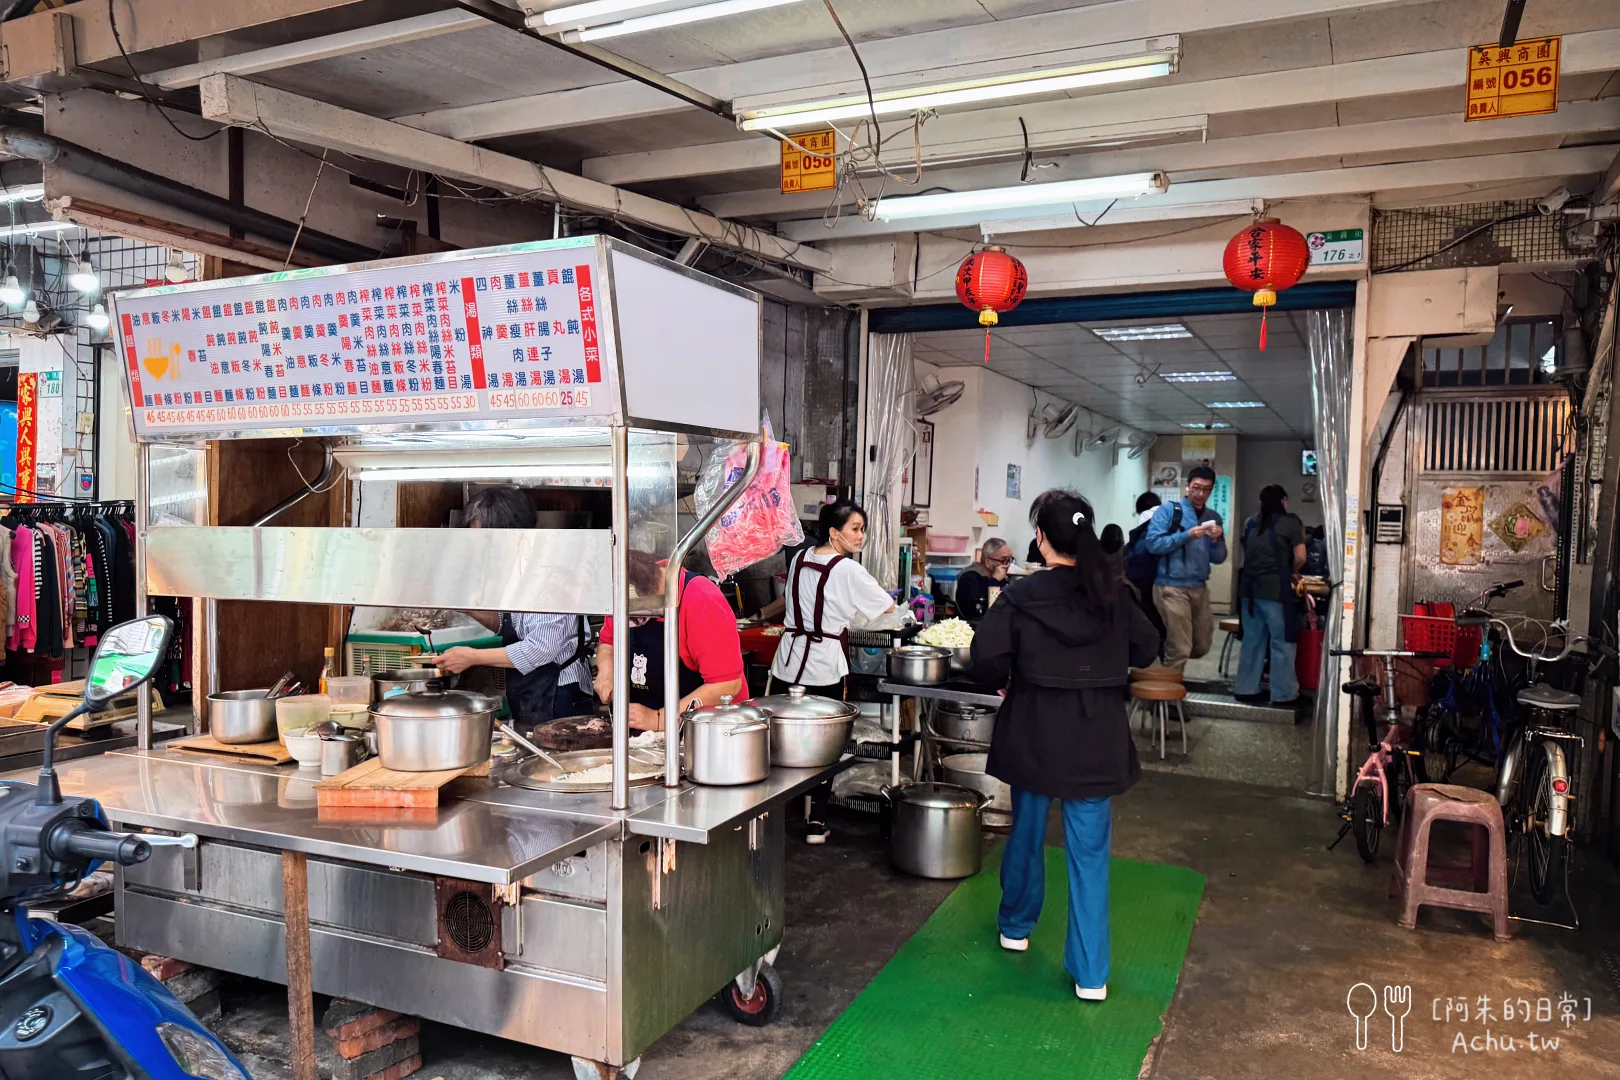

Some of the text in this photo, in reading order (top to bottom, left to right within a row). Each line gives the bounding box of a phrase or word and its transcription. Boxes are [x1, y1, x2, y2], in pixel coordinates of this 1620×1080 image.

[1469, 101, 1497, 115] 負責人
[1472, 66, 1552, 91] 編號 056
[803, 152, 832, 170] 058
[448, 279, 472, 389] 米粉湯
[463, 301, 482, 359] 湯類
[475, 276, 499, 388] 四神湯
[489, 274, 513, 387] 肉羹湯
[503, 273, 526, 386] 薑絲瘦肉湯
[517, 271, 541, 385] 薑絲肝連湯
[532, 270, 555, 385] 薑絲腸子湯
[547, 268, 570, 384] 貢丸湯
[561, 267, 584, 383] 餛飩湯
[577, 285, 599, 361] 各式小菜
[46, 382, 61, 394] 180
[145, 395, 476, 424] 45 45 45 45 45 45 45 60 60 60 60 60 60 60 55 55 55 55 55 55 55 55 55 55 55 55 55 55 30
[489, 389, 589, 409] 45 45 60 60 60 25 45
